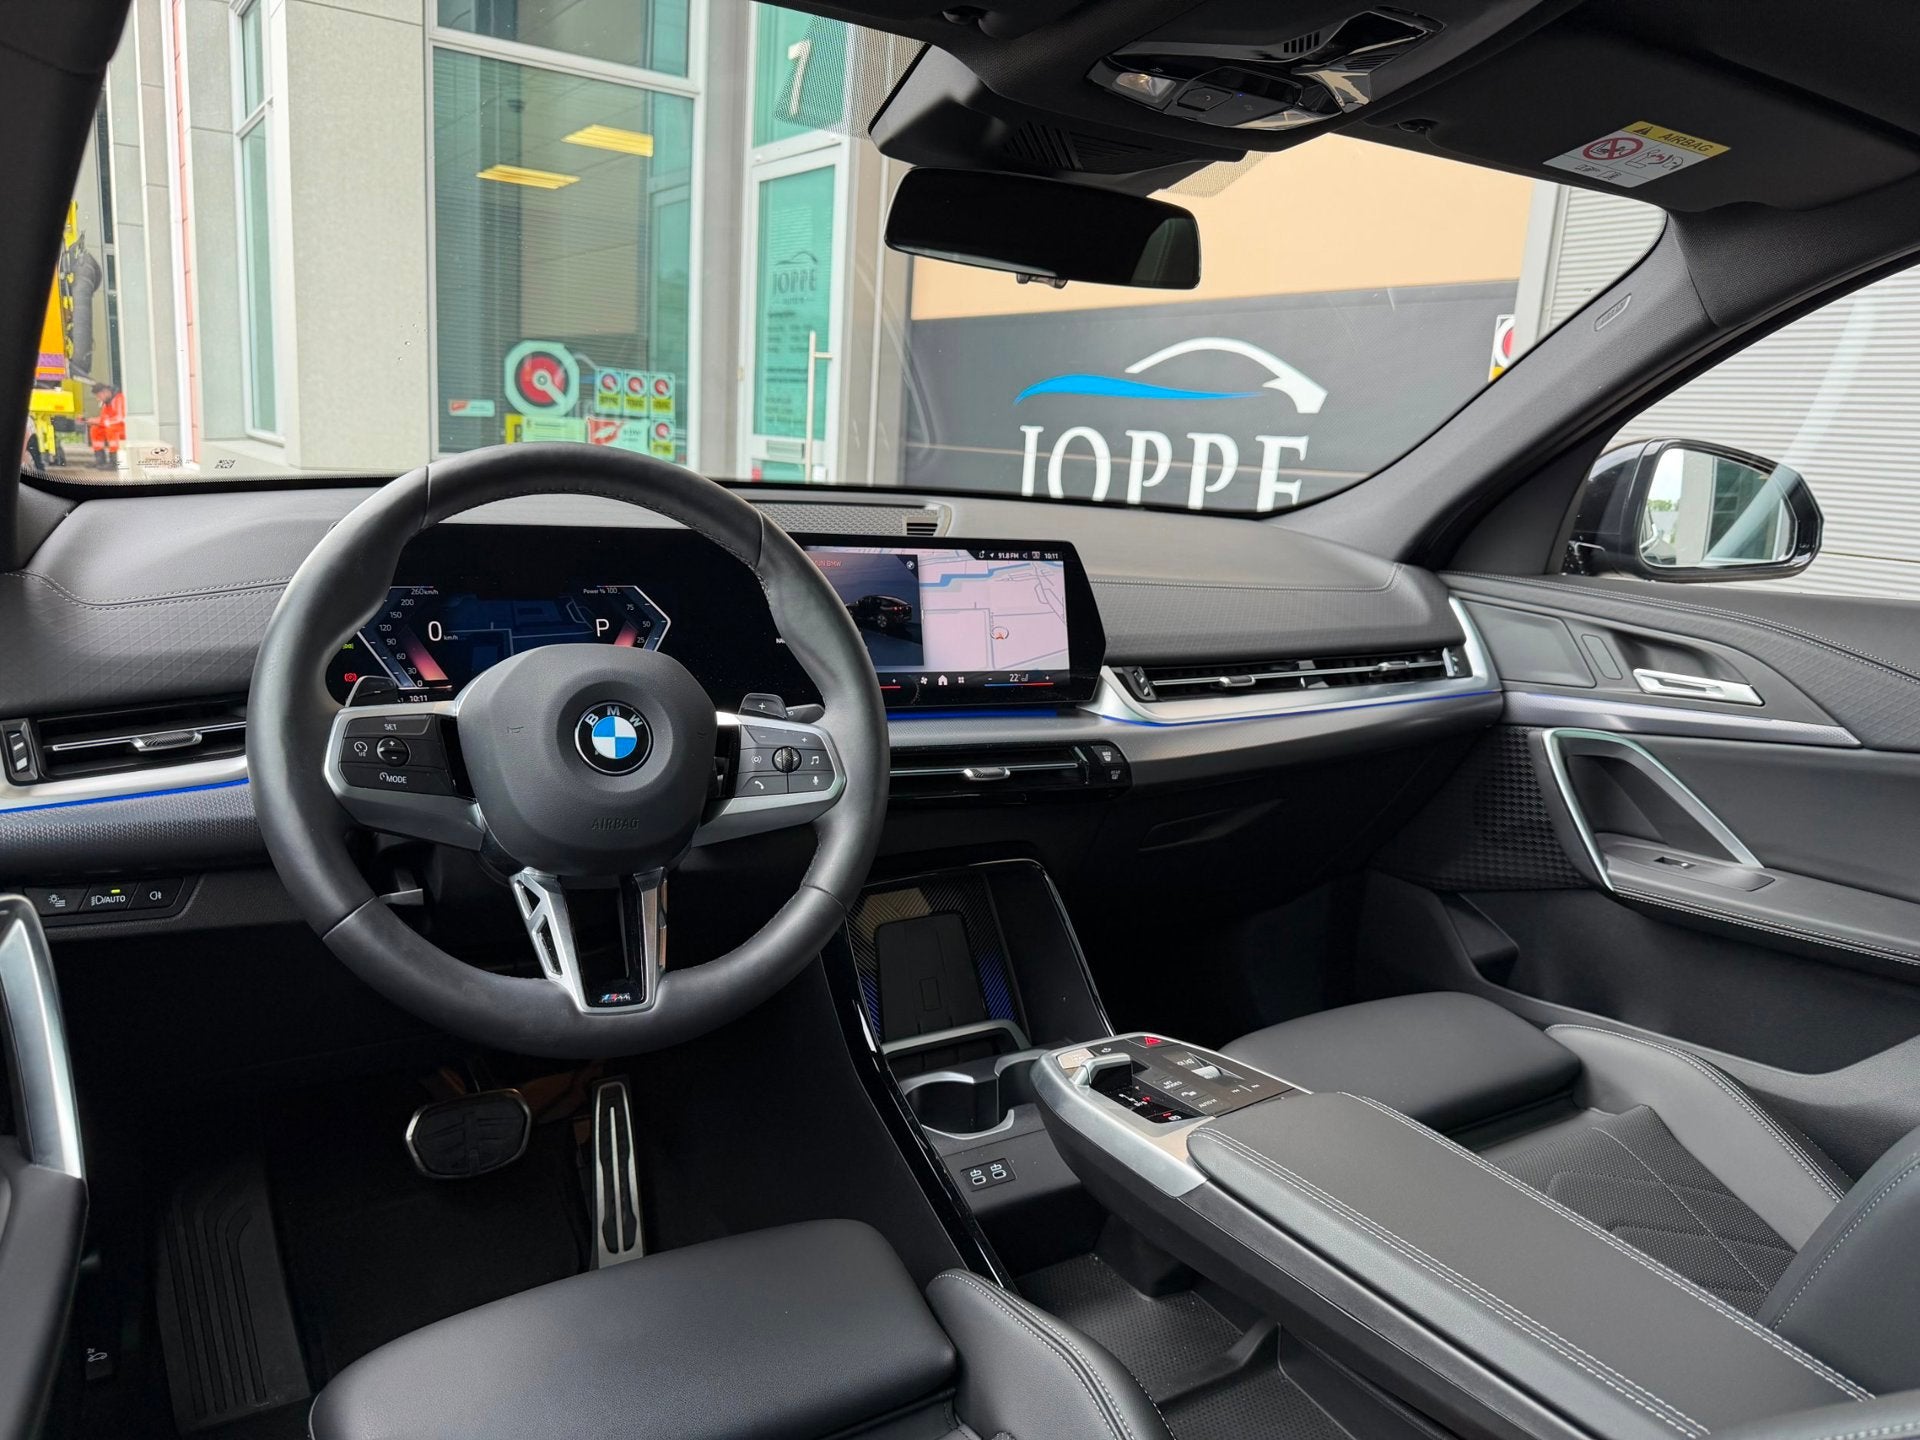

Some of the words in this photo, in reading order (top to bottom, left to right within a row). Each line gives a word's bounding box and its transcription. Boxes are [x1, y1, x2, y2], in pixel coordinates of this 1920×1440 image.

[1659, 133, 1714, 152] AIRBAG
[401, 598, 415, 606] 200
[626, 603, 635, 611] 75
[389, 611, 403, 619] 150
[379, 624, 392, 632] 120
[595, 618, 610, 637] P
[642, 620, 651, 628] 50
[428, 620, 443, 642] 0
[386, 638, 397, 646] 90
[636, 636, 645, 644] 25
[396, 652, 406, 660] 60
[407, 667, 417, 675] 30
[409, 694, 428, 702] 10:11
[584, 705, 644, 727] BMW
[383, 723, 398, 731] SET
[386, 775, 408, 784] MODE
[591, 816, 640, 831] AIRBAG
